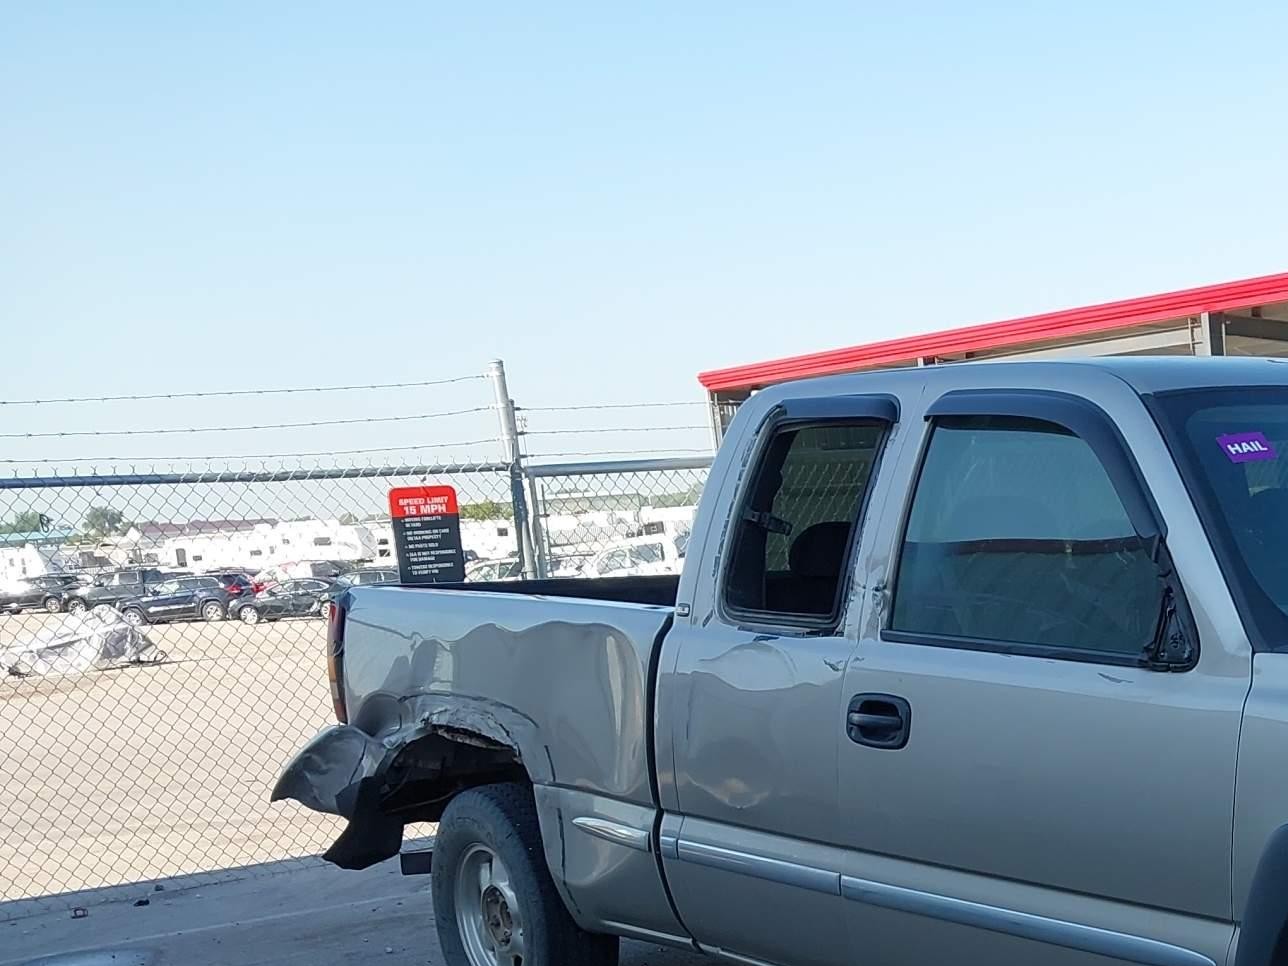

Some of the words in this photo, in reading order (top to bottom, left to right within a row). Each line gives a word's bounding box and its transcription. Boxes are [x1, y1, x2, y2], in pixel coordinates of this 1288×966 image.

[1226, 440, 1268, 455] HAIL
[404, 506, 416, 514] 15
[421, 504, 447, 514] MPH
